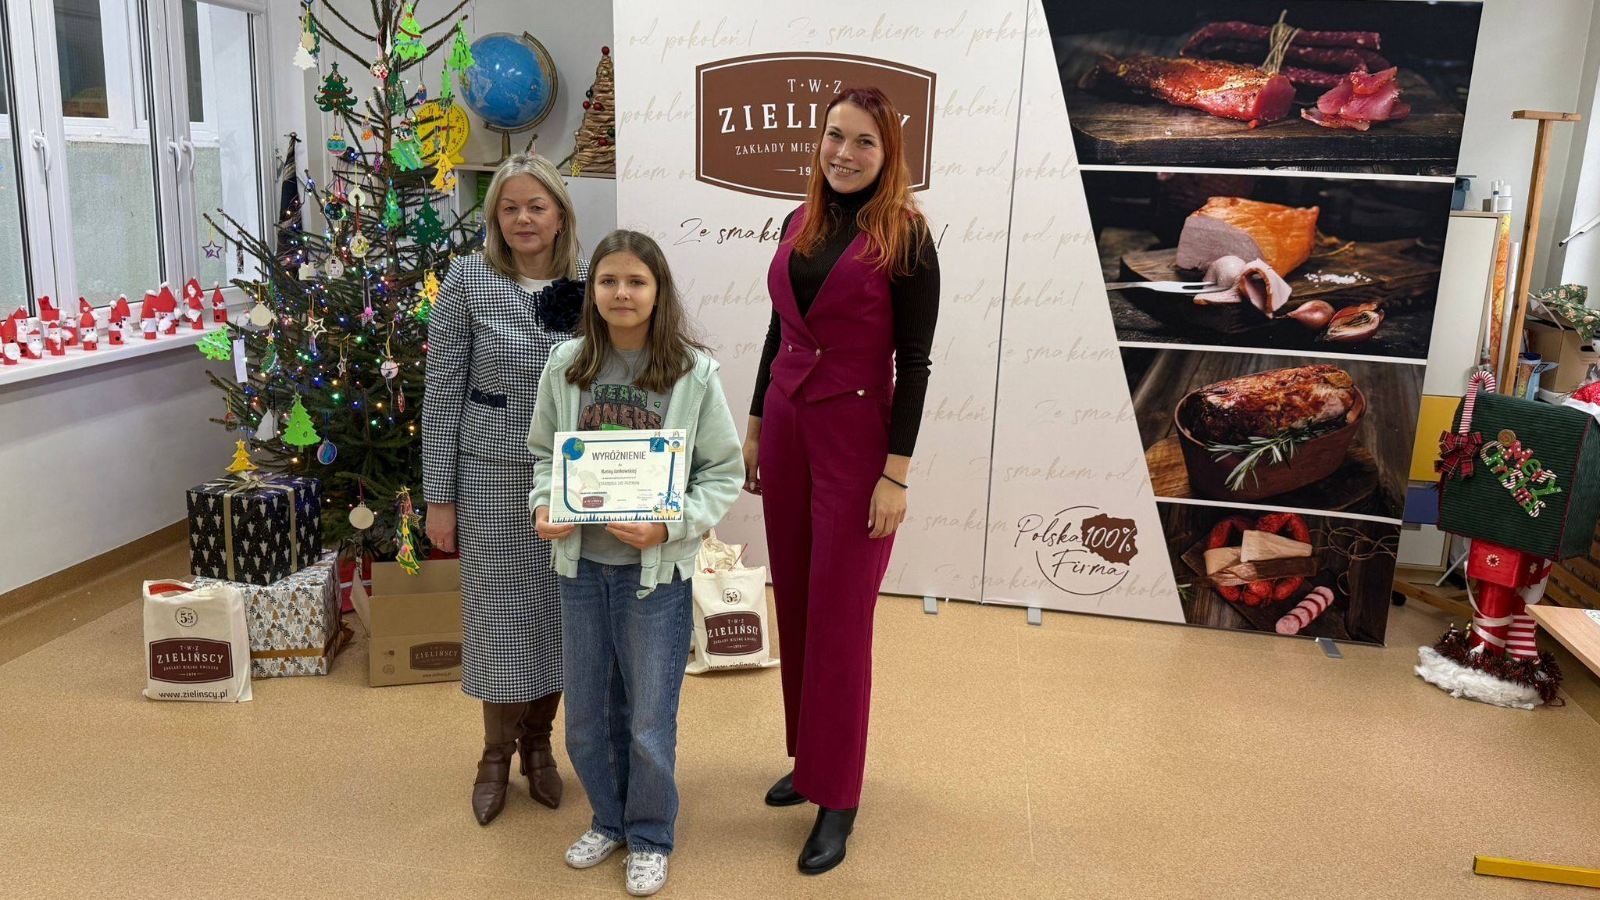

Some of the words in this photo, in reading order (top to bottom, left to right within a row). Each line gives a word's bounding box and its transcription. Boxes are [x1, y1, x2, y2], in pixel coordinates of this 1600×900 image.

[735, 142, 785, 156] ZAKŁADY
[790, 142, 818, 155] MIĘS
[673, 217, 711, 246] Ze
[717, 216, 781, 245] smaki
[1014, 513, 1083, 548] Polska
[1084, 526, 1136, 554] 100%
[1052, 549, 1125, 578] Firma
[156, 652, 224, 664] ZIELIŃSCY
[158, 689, 228, 699] www.zielinscy.pl
